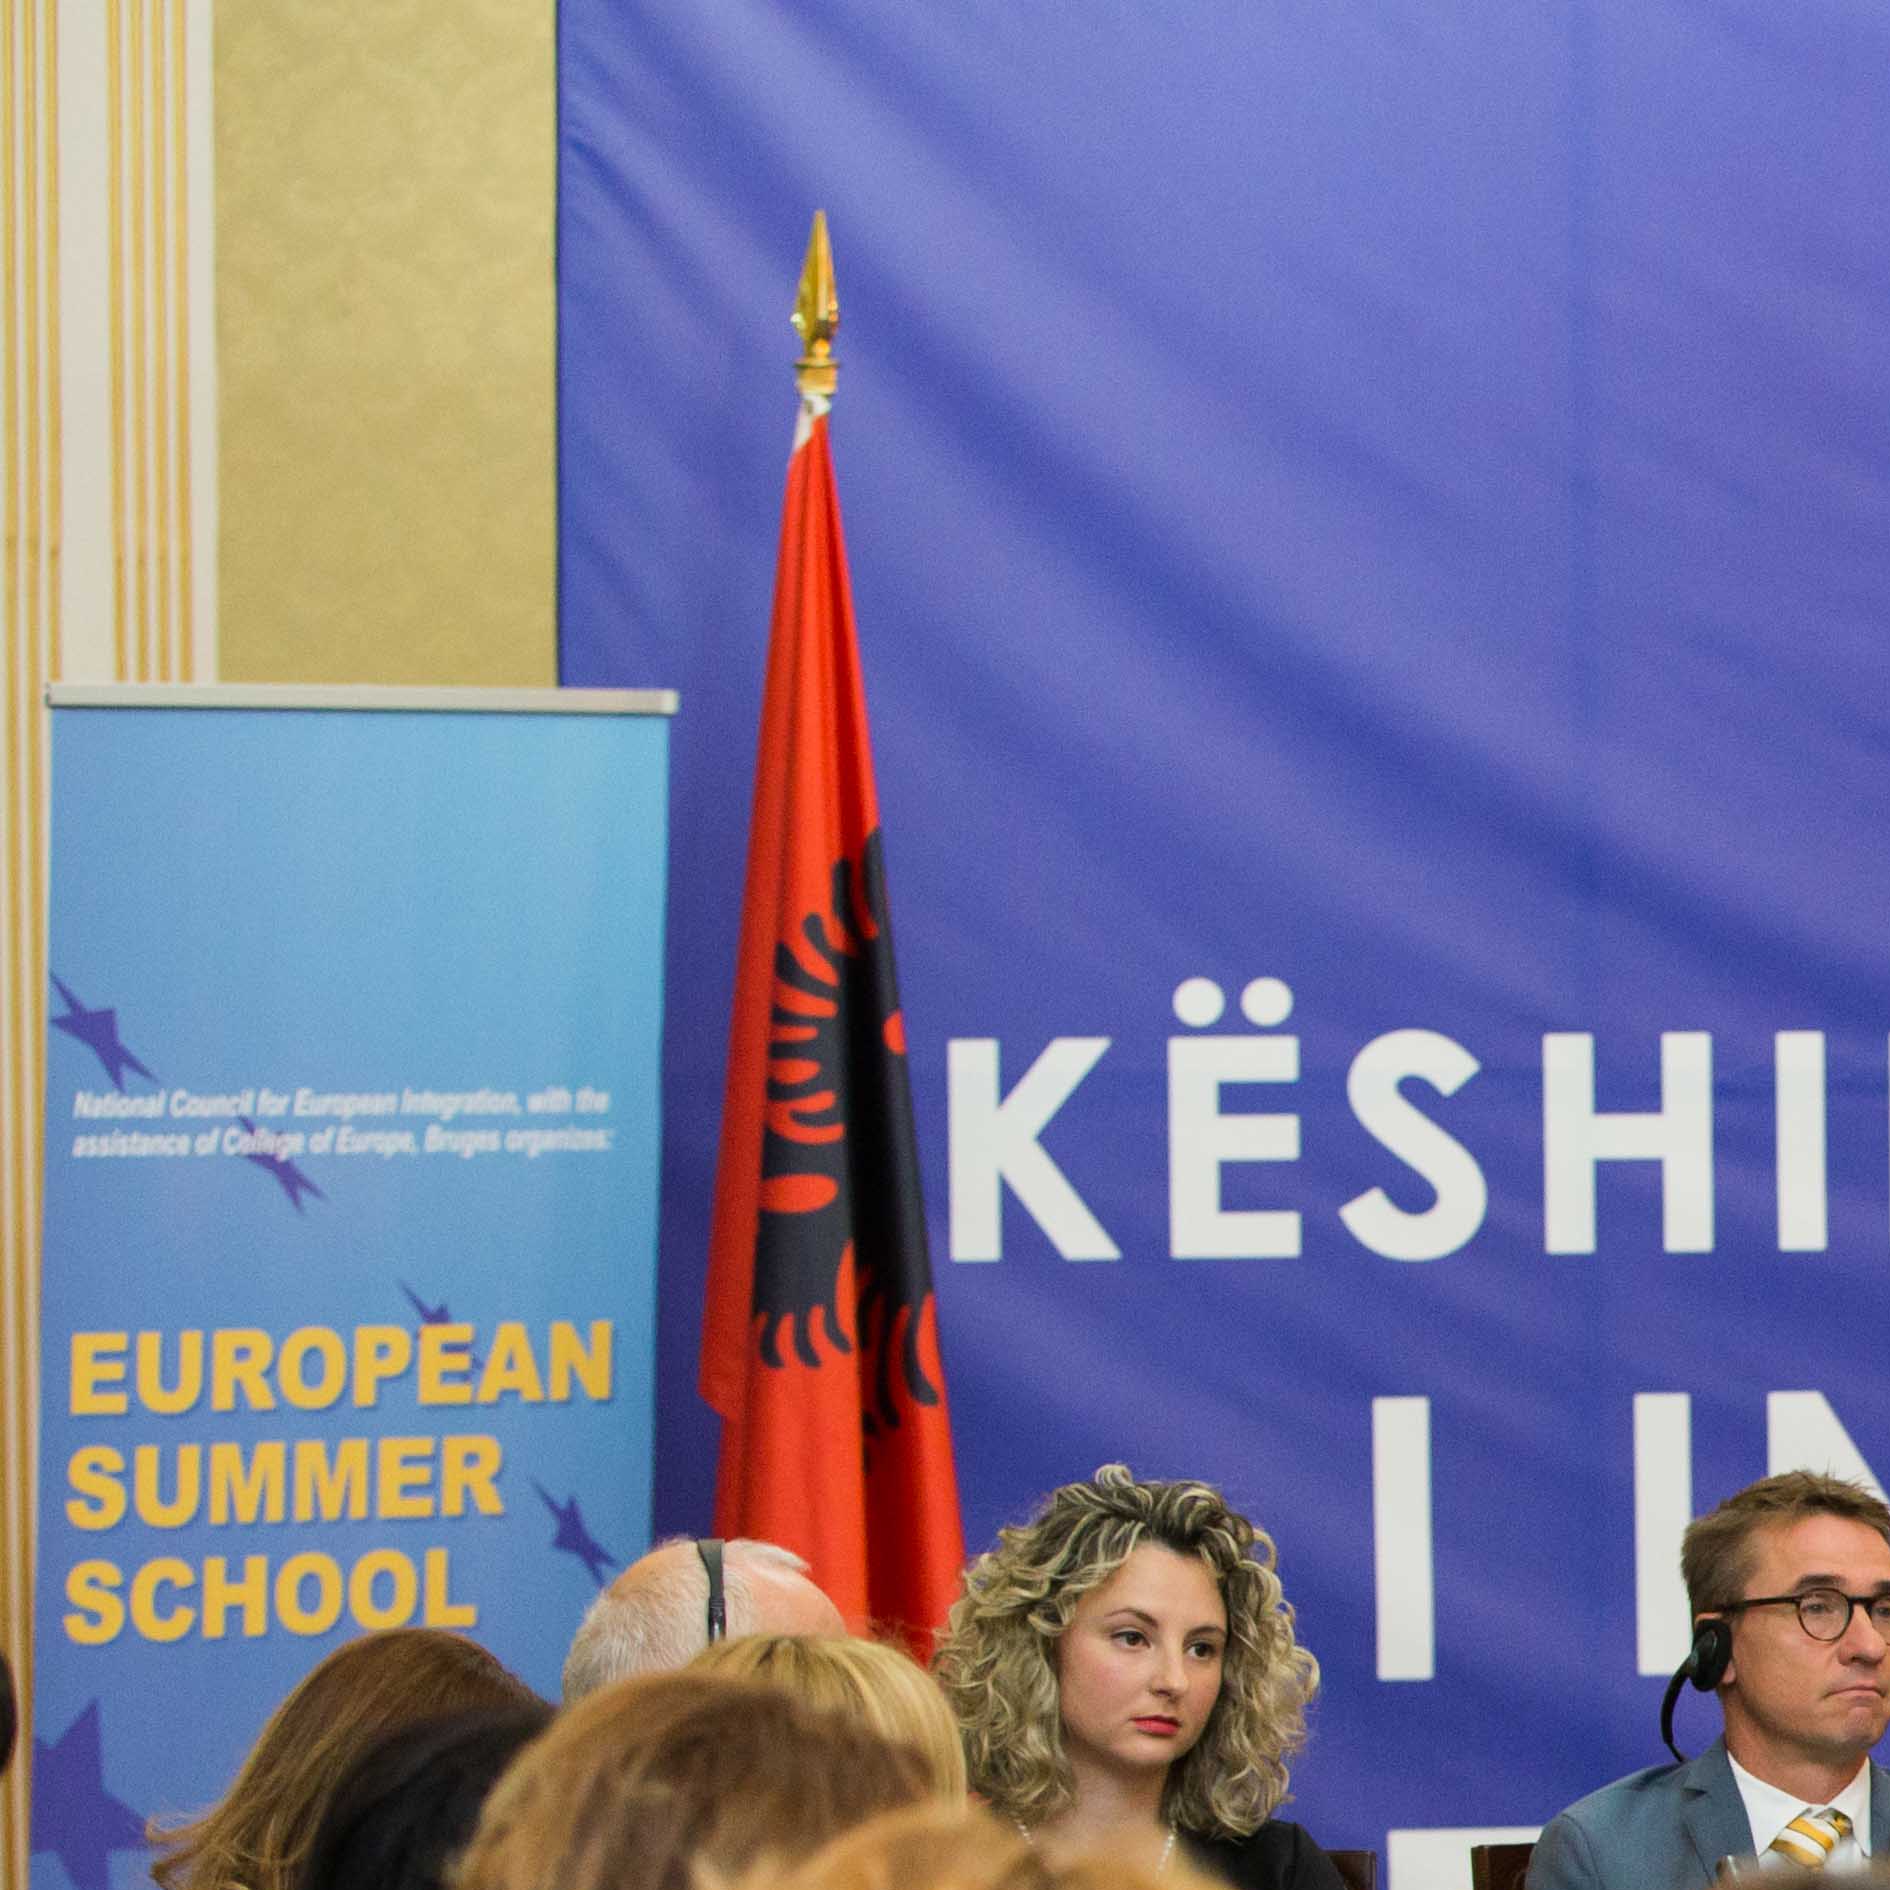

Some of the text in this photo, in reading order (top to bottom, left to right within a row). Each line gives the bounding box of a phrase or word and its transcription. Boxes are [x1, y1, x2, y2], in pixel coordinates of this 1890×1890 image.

[69, 1320, 612, 1414] EUROPEAN
[65, 1435, 504, 1531] SUMMER
[1370, 1395, 1437, 1682] I
[63, 1548, 477, 1644] SCHOOL
